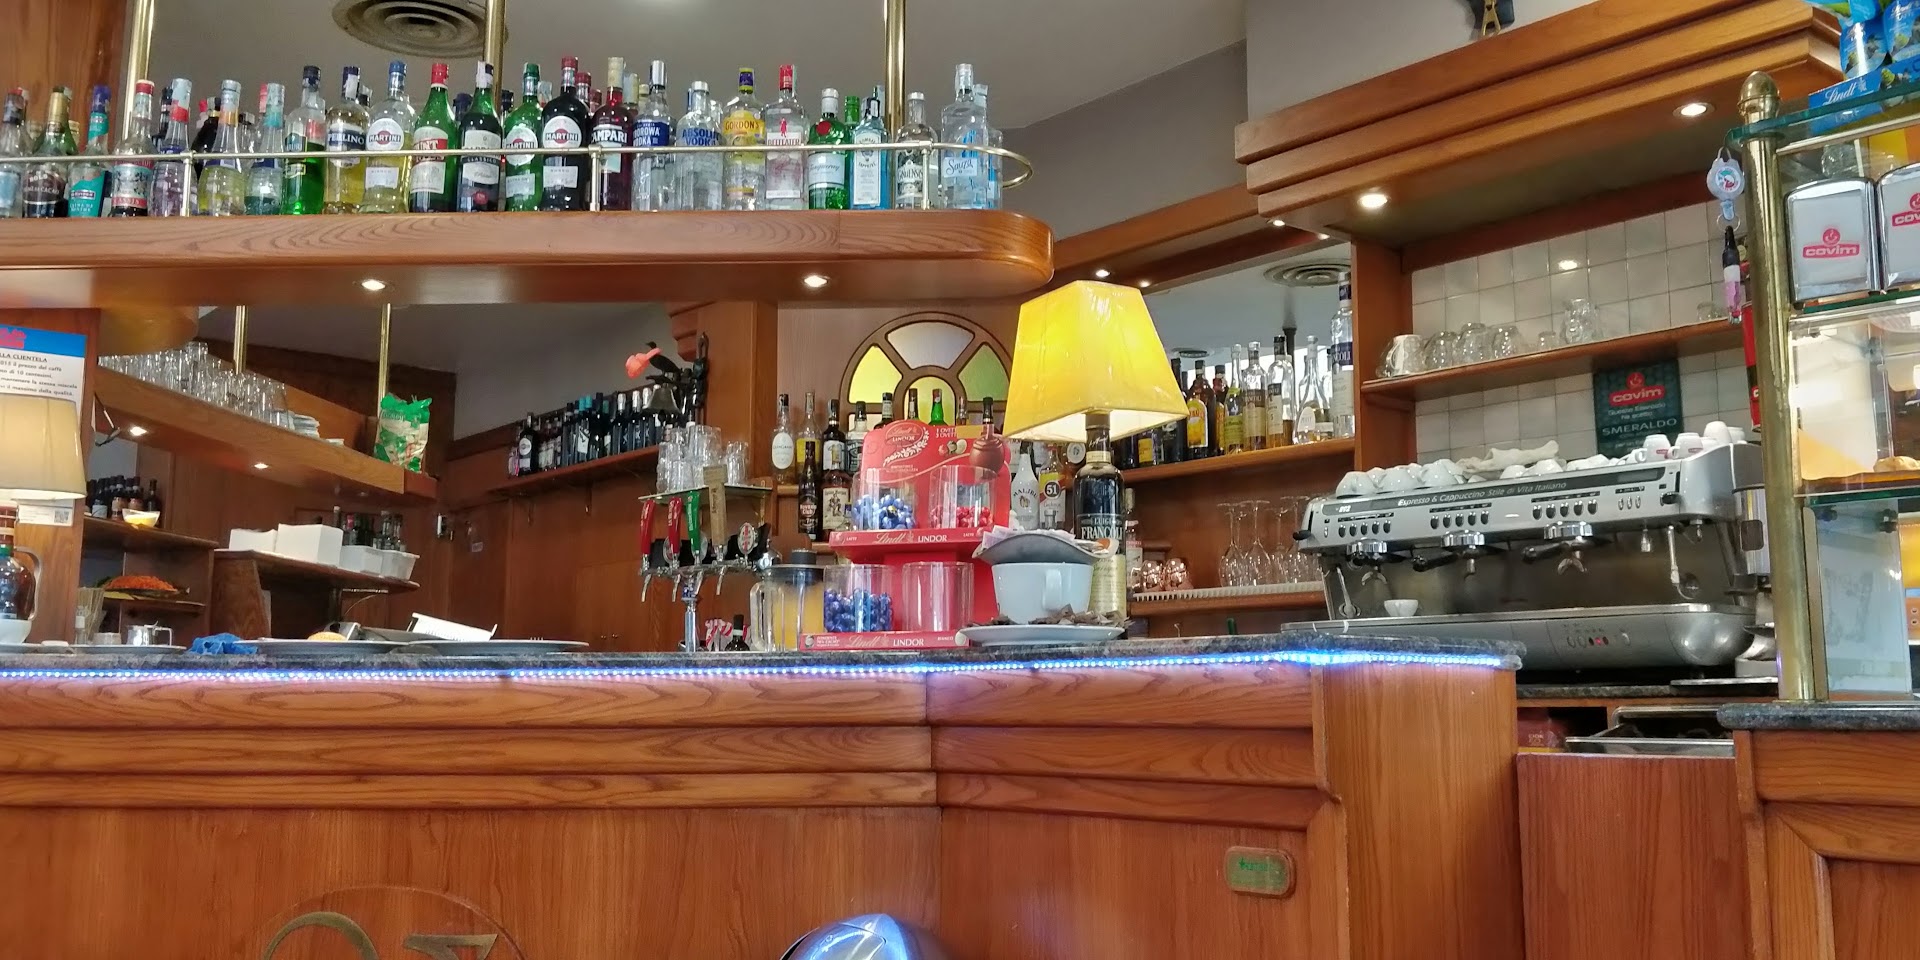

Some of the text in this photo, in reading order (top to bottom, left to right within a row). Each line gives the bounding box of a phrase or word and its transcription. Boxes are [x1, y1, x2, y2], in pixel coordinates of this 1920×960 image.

[1823, 82, 1857, 105] Lindt
[368, 134, 401, 143] MARTINI
[545, 132, 579, 142] MARTINI
[945, 159, 974, 175] Sauza
[1805, 245, 1857, 257] covim
[13, 354, 47, 363] CLIENTELA
[1612, 387, 1662, 403] covim
[1602, 418, 1677, 436] SMERALDO
[1046, 484, 1058, 495] 51
[1397, 497, 1431, 507] Espresso
[1439, 489, 1486, 503] Cappuccino
[1487, 487, 1505, 496] Stile
[1506, 487, 1515, 495] di
[1516, 485, 1534, 493] Vita
[1534, 482, 1567, 492] Italiano
[872, 533, 948, 544] Lindt LINDOR
[1081, 526, 1123, 540] FRANCOLI
[848, 635, 881, 648] Lindt
[893, 638, 924, 647] LINDOR
